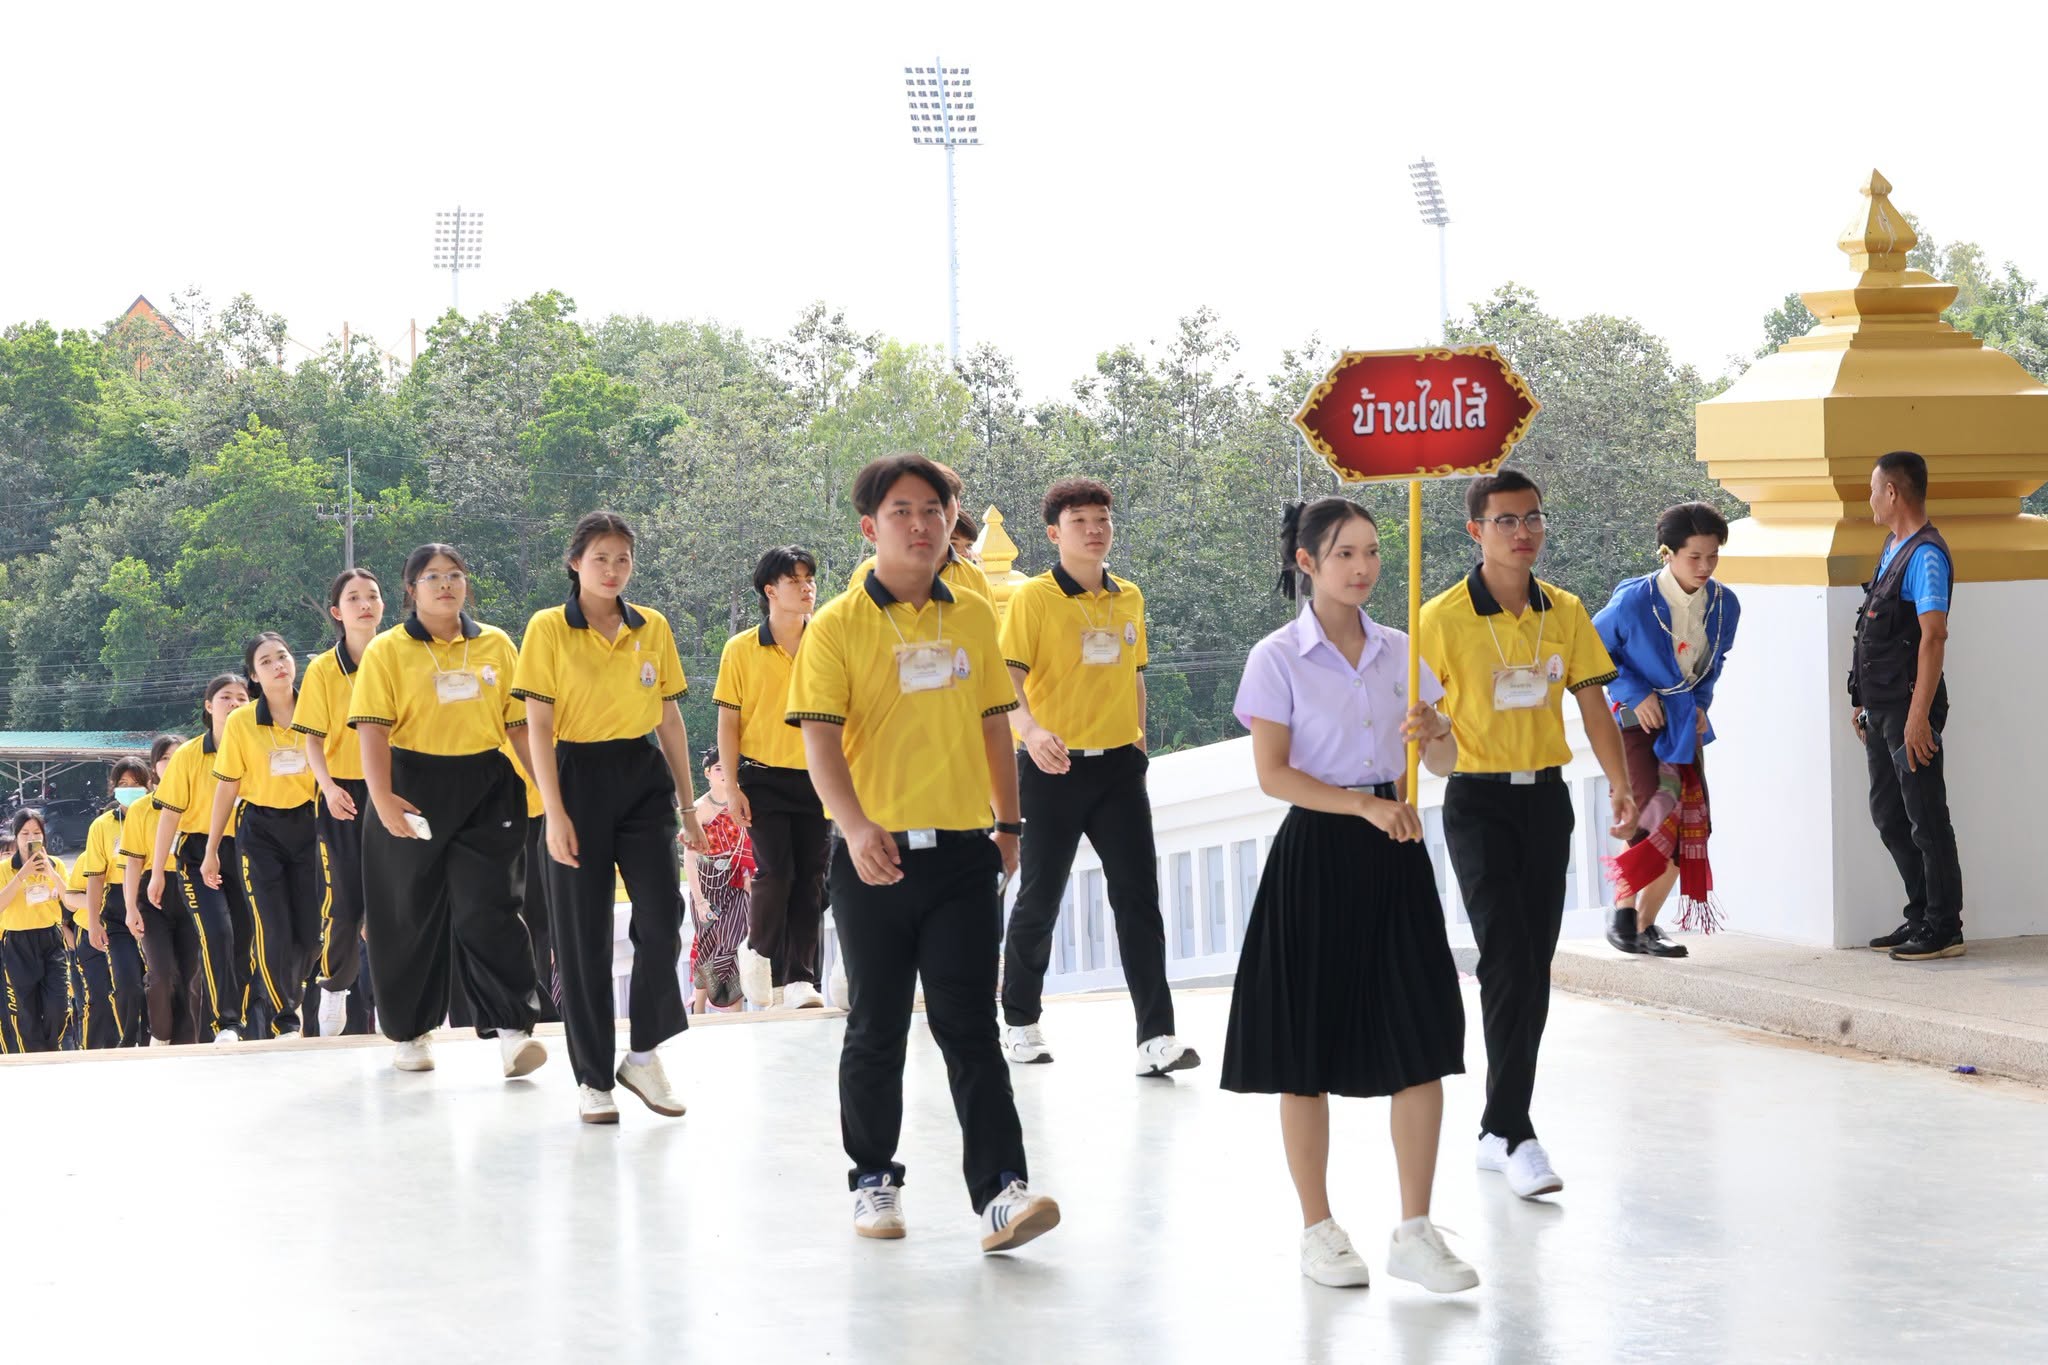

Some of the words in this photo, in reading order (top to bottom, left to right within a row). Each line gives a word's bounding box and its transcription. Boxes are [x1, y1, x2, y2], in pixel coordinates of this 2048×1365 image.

[1352, 378, 1487, 435] บ้านไทโส้
[184, 883, 198, 908] NPU
[7, 986, 17, 1012] NPU
